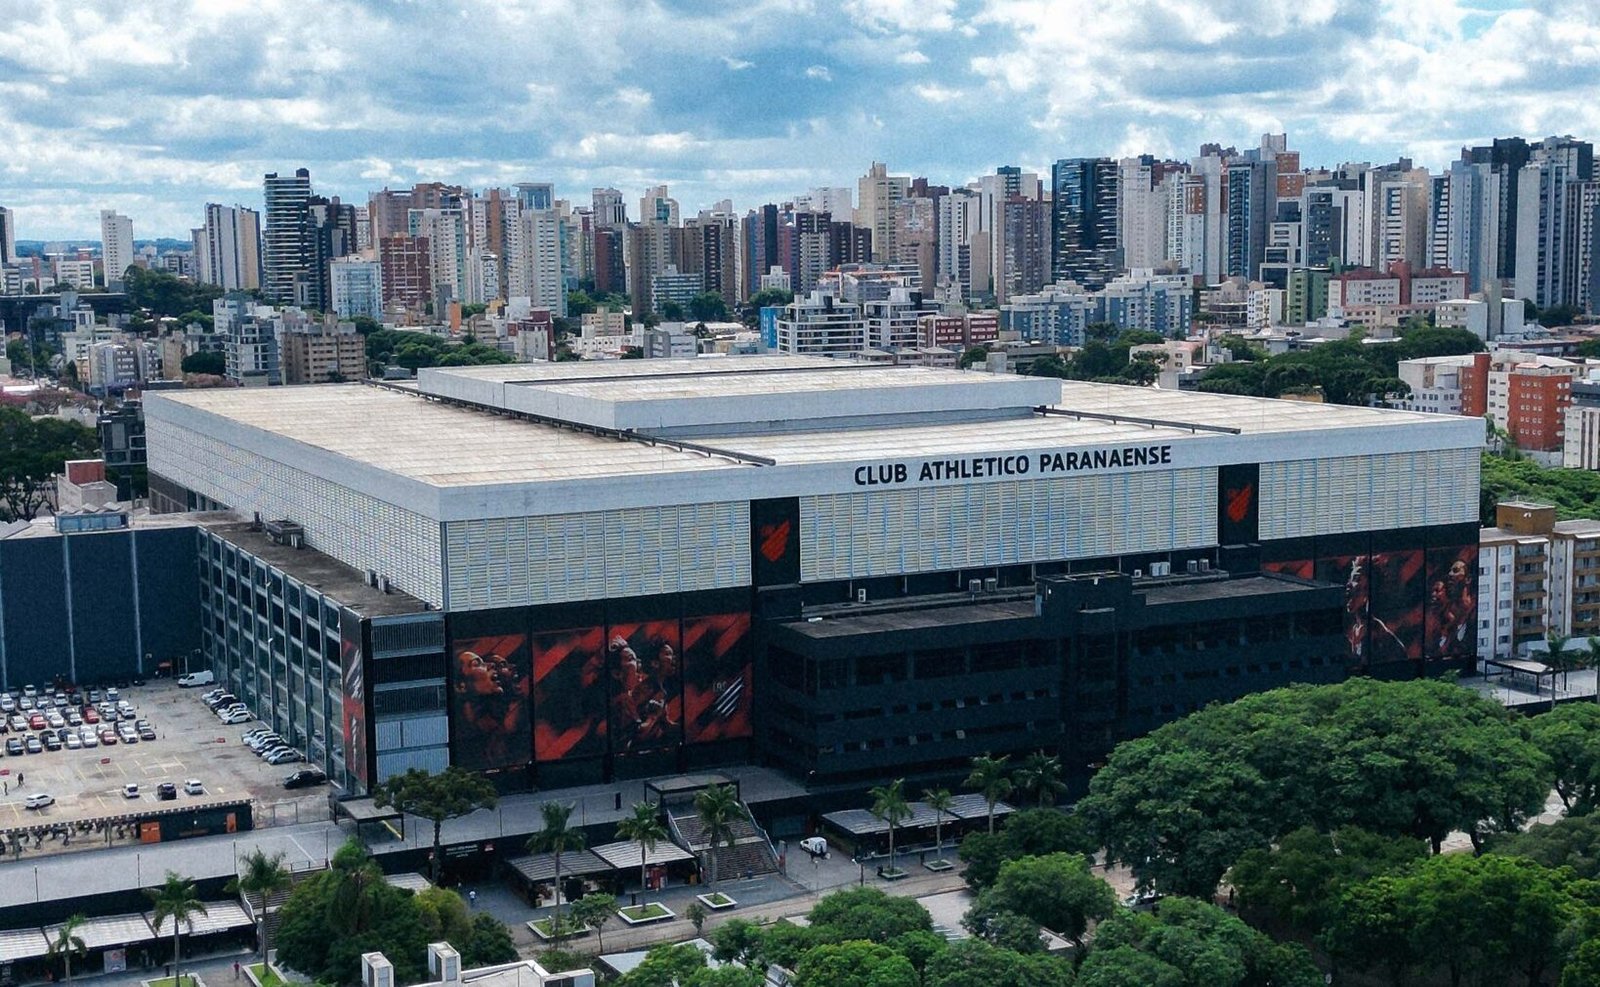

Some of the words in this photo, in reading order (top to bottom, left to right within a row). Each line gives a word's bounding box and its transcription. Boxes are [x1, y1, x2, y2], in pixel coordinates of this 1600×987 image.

[854, 463, 908, 486] CLUB
[918, 455, 1030, 482] ATHLETICO
[1039, 445, 1172, 473] PARANAENSE
